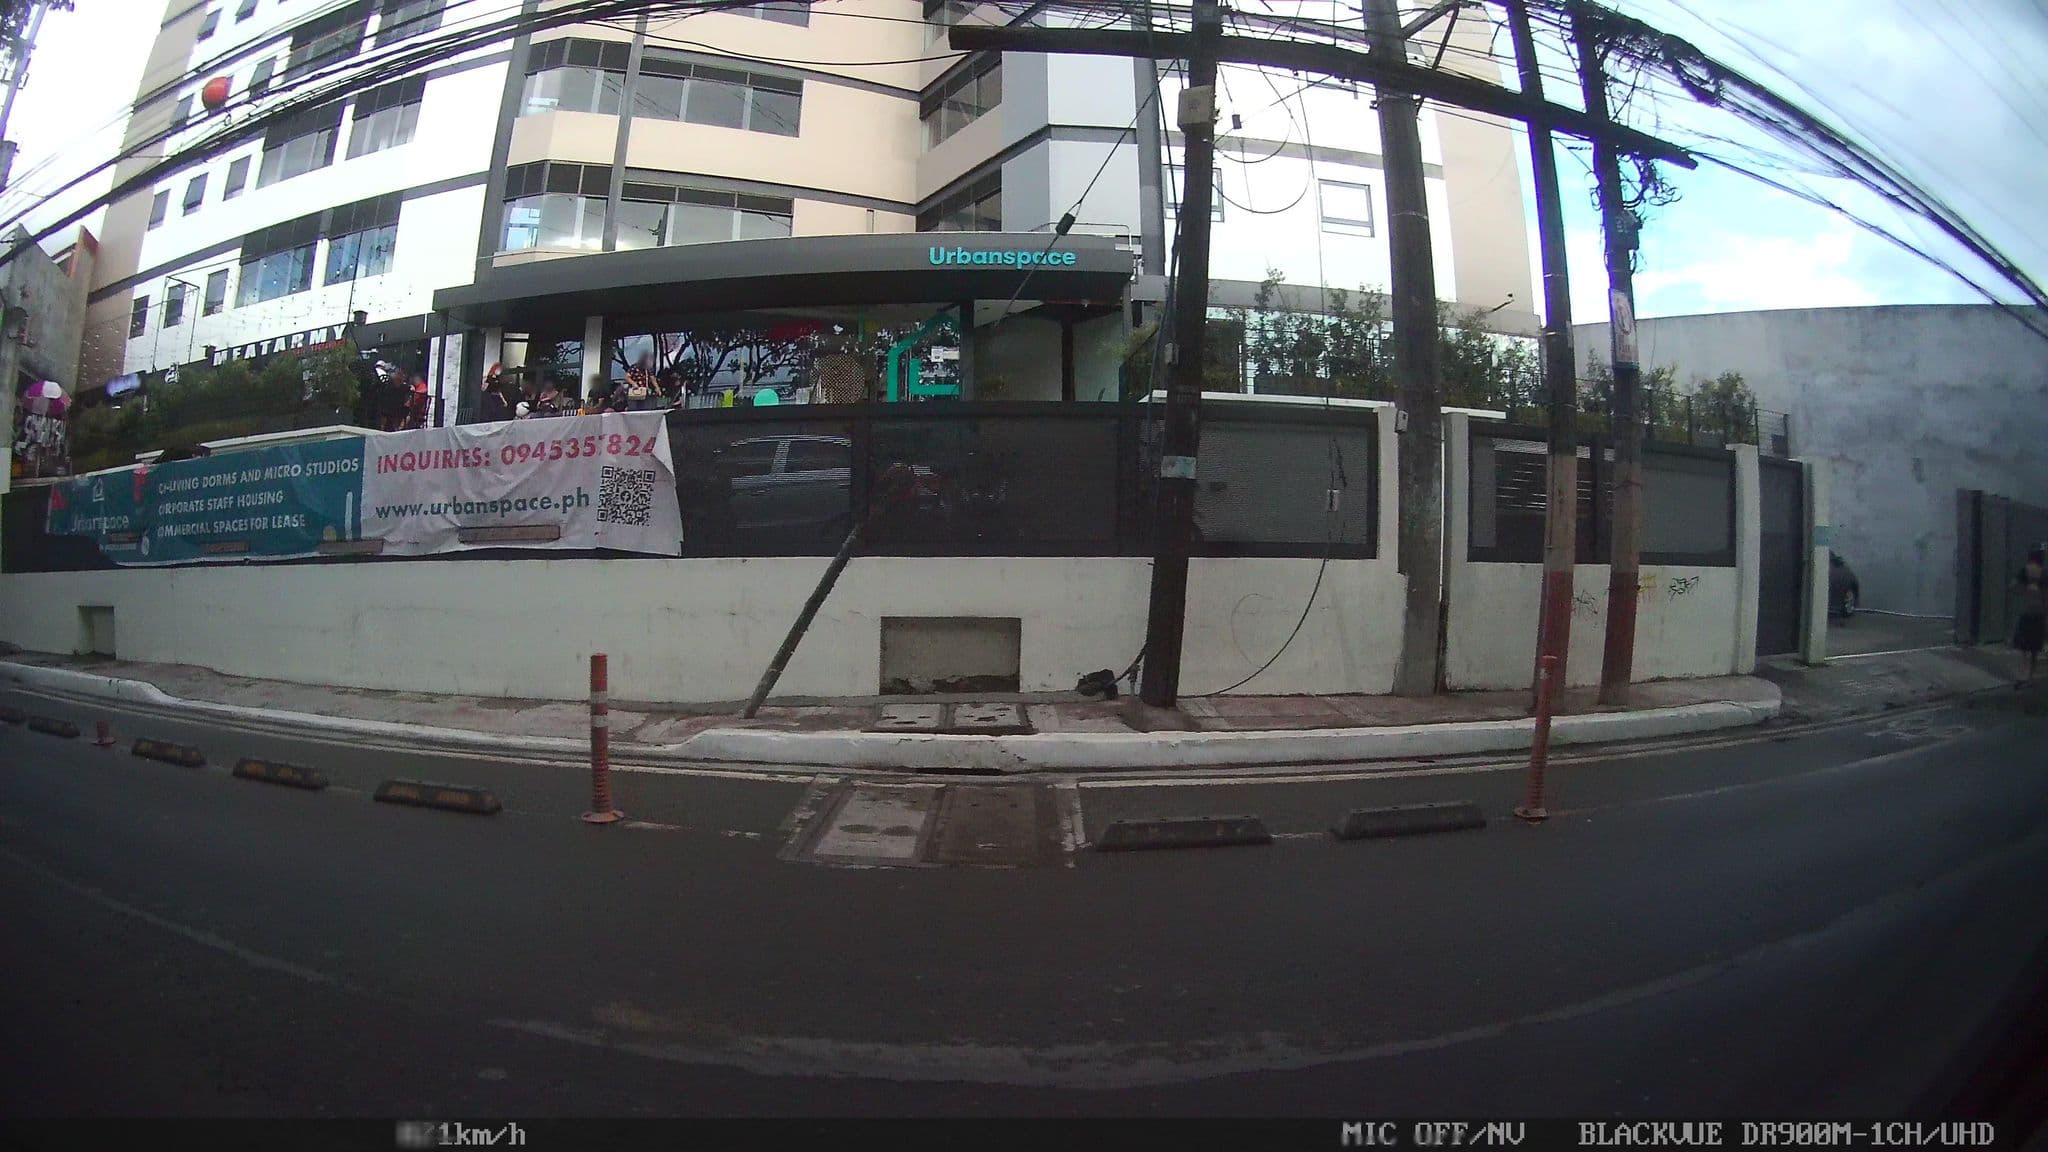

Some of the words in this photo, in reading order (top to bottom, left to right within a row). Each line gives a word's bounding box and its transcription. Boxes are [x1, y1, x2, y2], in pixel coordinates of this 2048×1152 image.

[929, 246, 1077, 269] Urbanspace
[377, 446, 491, 474] INQUIRIES:
[501, 434, 657, 466] 094535824
[202, 472, 237, 489] DORMS
[239, 469, 261, 484] AND
[263, 464, 302, 481] MICRO
[305, 458, 359, 477] STUDIOS
[207, 496, 234, 511] STAFF
[237, 489, 284, 508] HOUSING
[375, 486, 590, 518] www.urbanspace.ph
[213, 519, 248, 534] SPACES
[249, 516, 269, 531] FOR
[272, 513, 306, 529] LEASE
